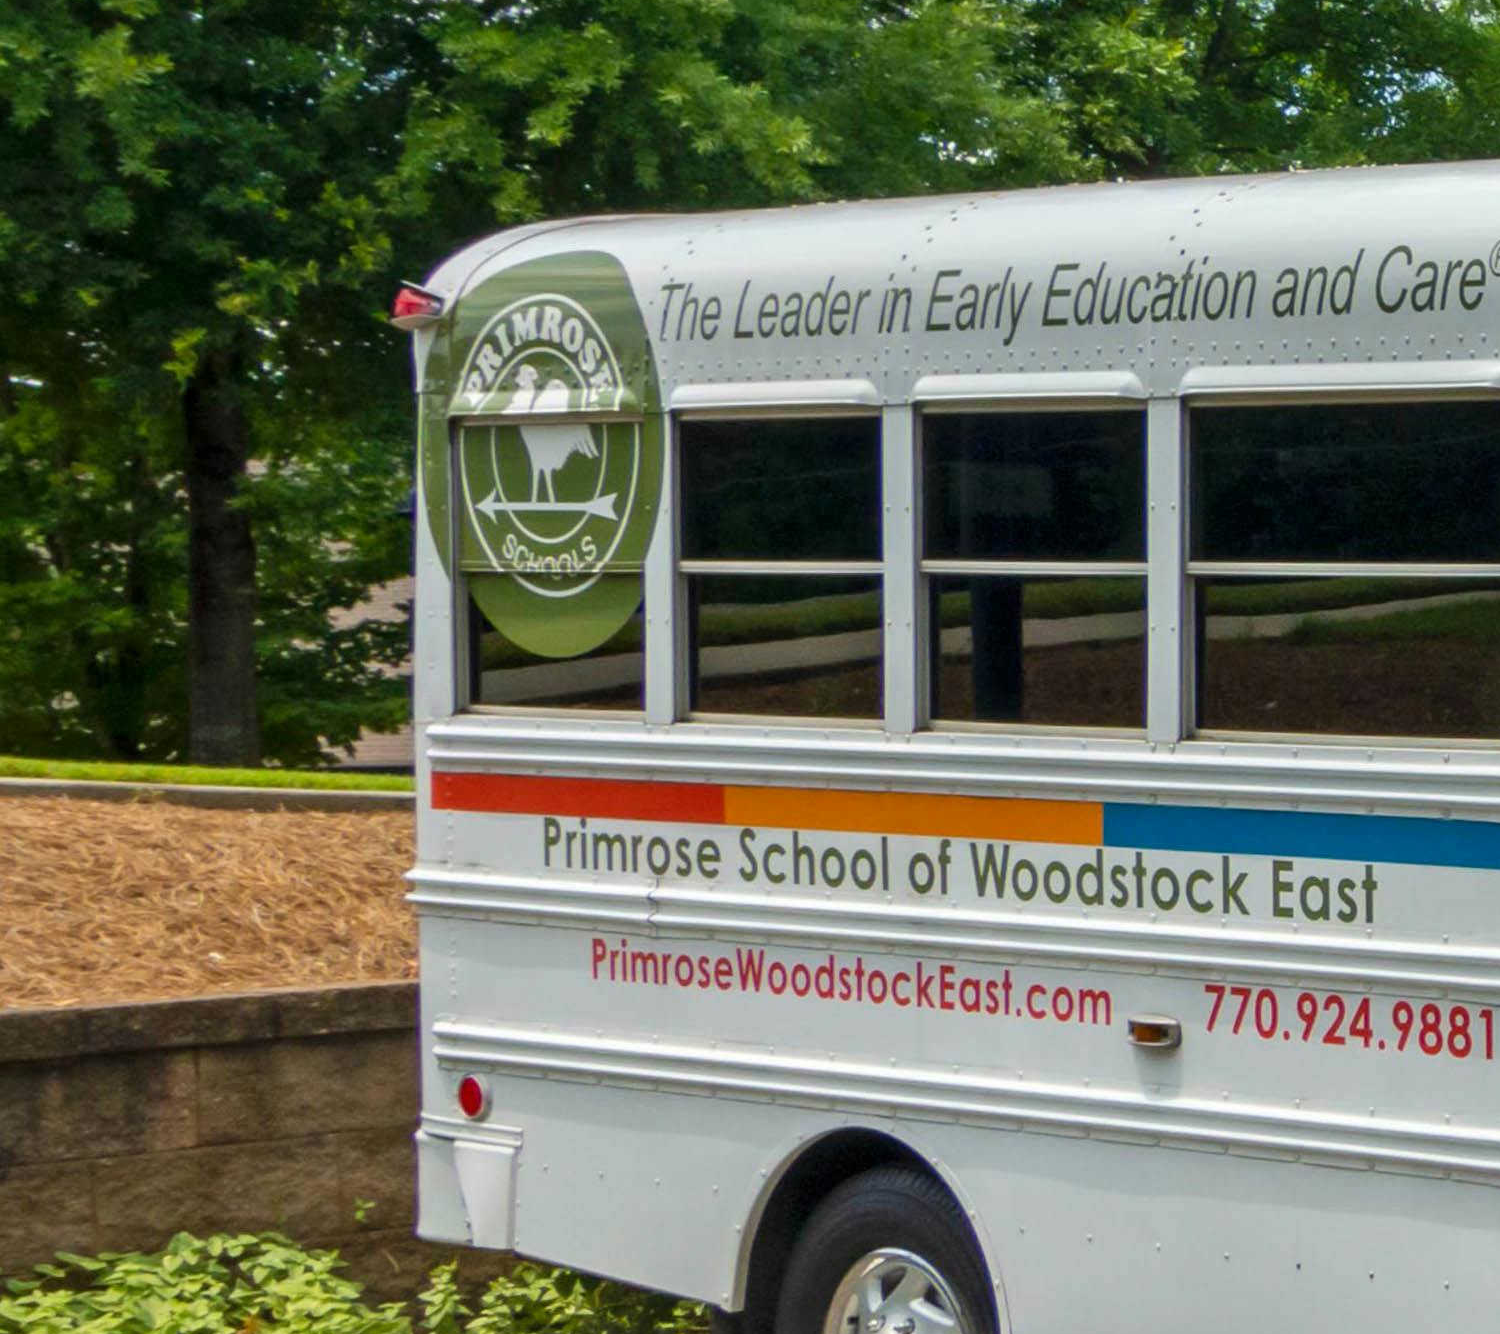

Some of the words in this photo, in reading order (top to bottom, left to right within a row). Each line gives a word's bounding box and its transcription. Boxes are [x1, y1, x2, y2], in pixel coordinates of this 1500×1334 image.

[658, 283, 723, 342] The
[733, 276, 872, 340] Leader
[878, 273, 912, 334] in
[924, 266, 1033, 347] Early
[1041, 256, 1257, 327] Education
[1272, 248, 1366, 317] and
[464, 305, 614, 408] PRIMROSE
[502, 534, 597, 580] SCHOOLS
[543, 817, 722, 879] Primrose
[739, 827, 890, 892] School
[908, 838, 952, 895] of
[969, 842, 1251, 916] Woodstock
[1272, 859, 1379, 924] East
[591, 938, 1112, 1026] PrimroseWoodstockEast.com
[1204, 984, 1494, 1060] 770.924.9881
